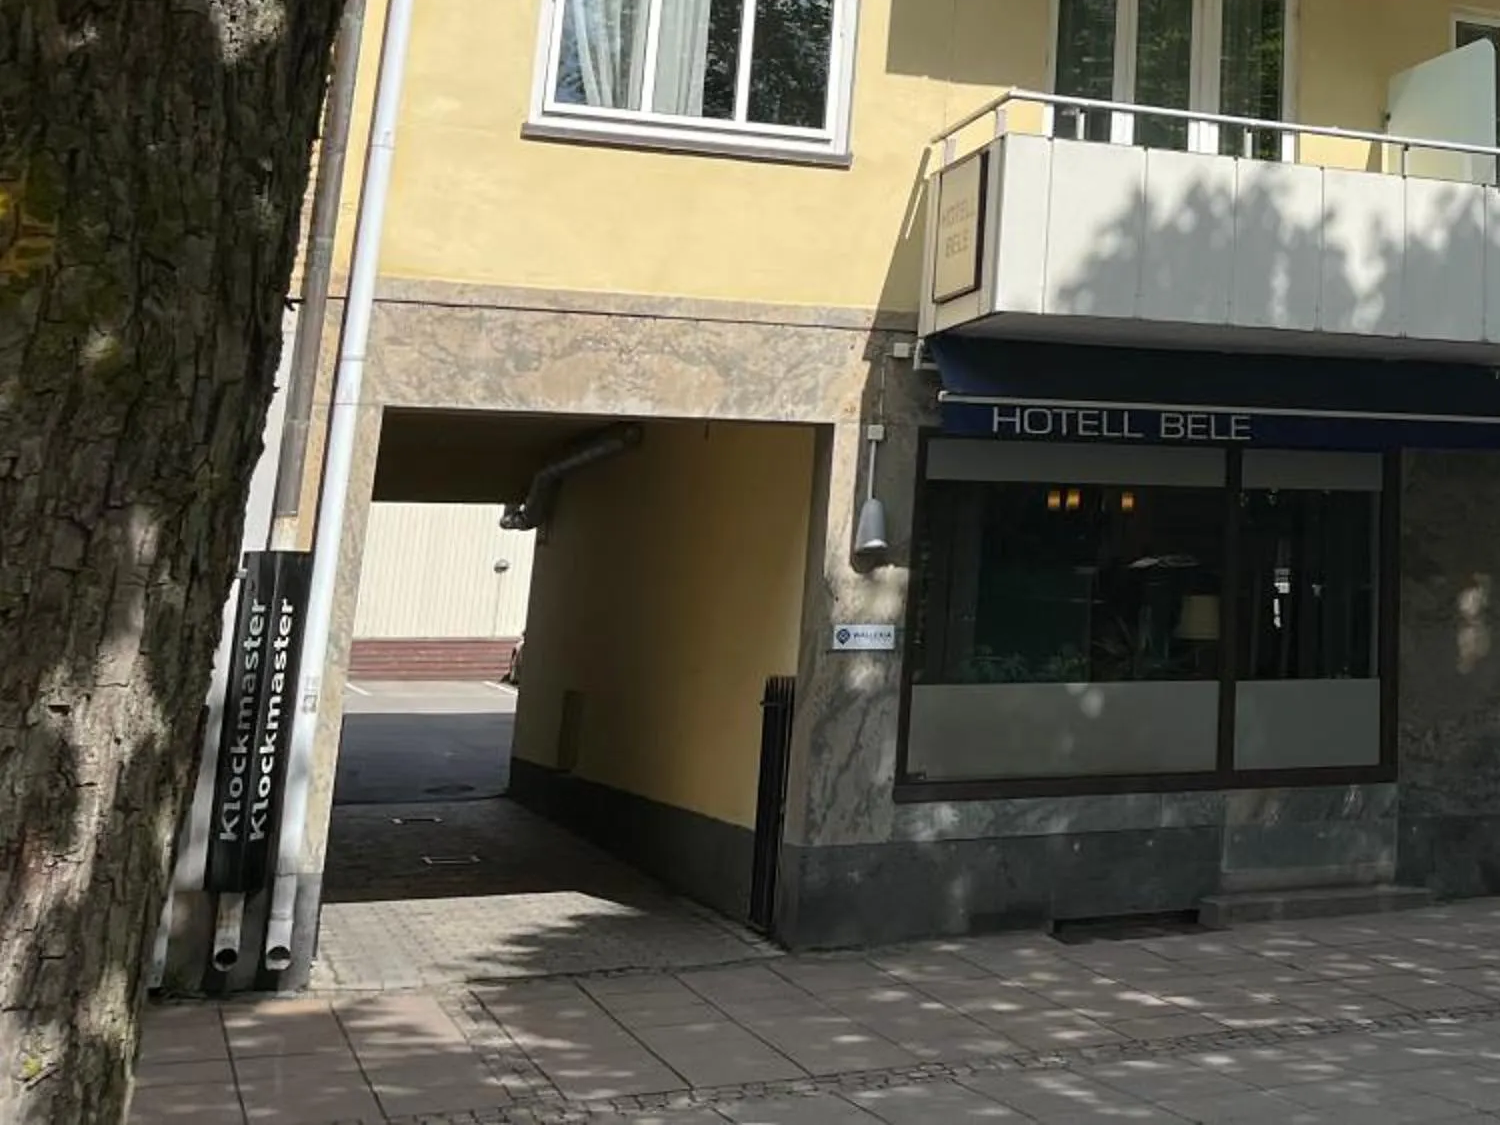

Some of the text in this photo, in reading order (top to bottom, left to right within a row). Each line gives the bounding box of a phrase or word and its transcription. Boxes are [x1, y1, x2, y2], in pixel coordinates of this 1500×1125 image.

[992, 406, 1252, 440] HOTELL BELE
[219, 598, 266, 842] Klockmaster
[249, 598, 294, 841] Klockmaster
